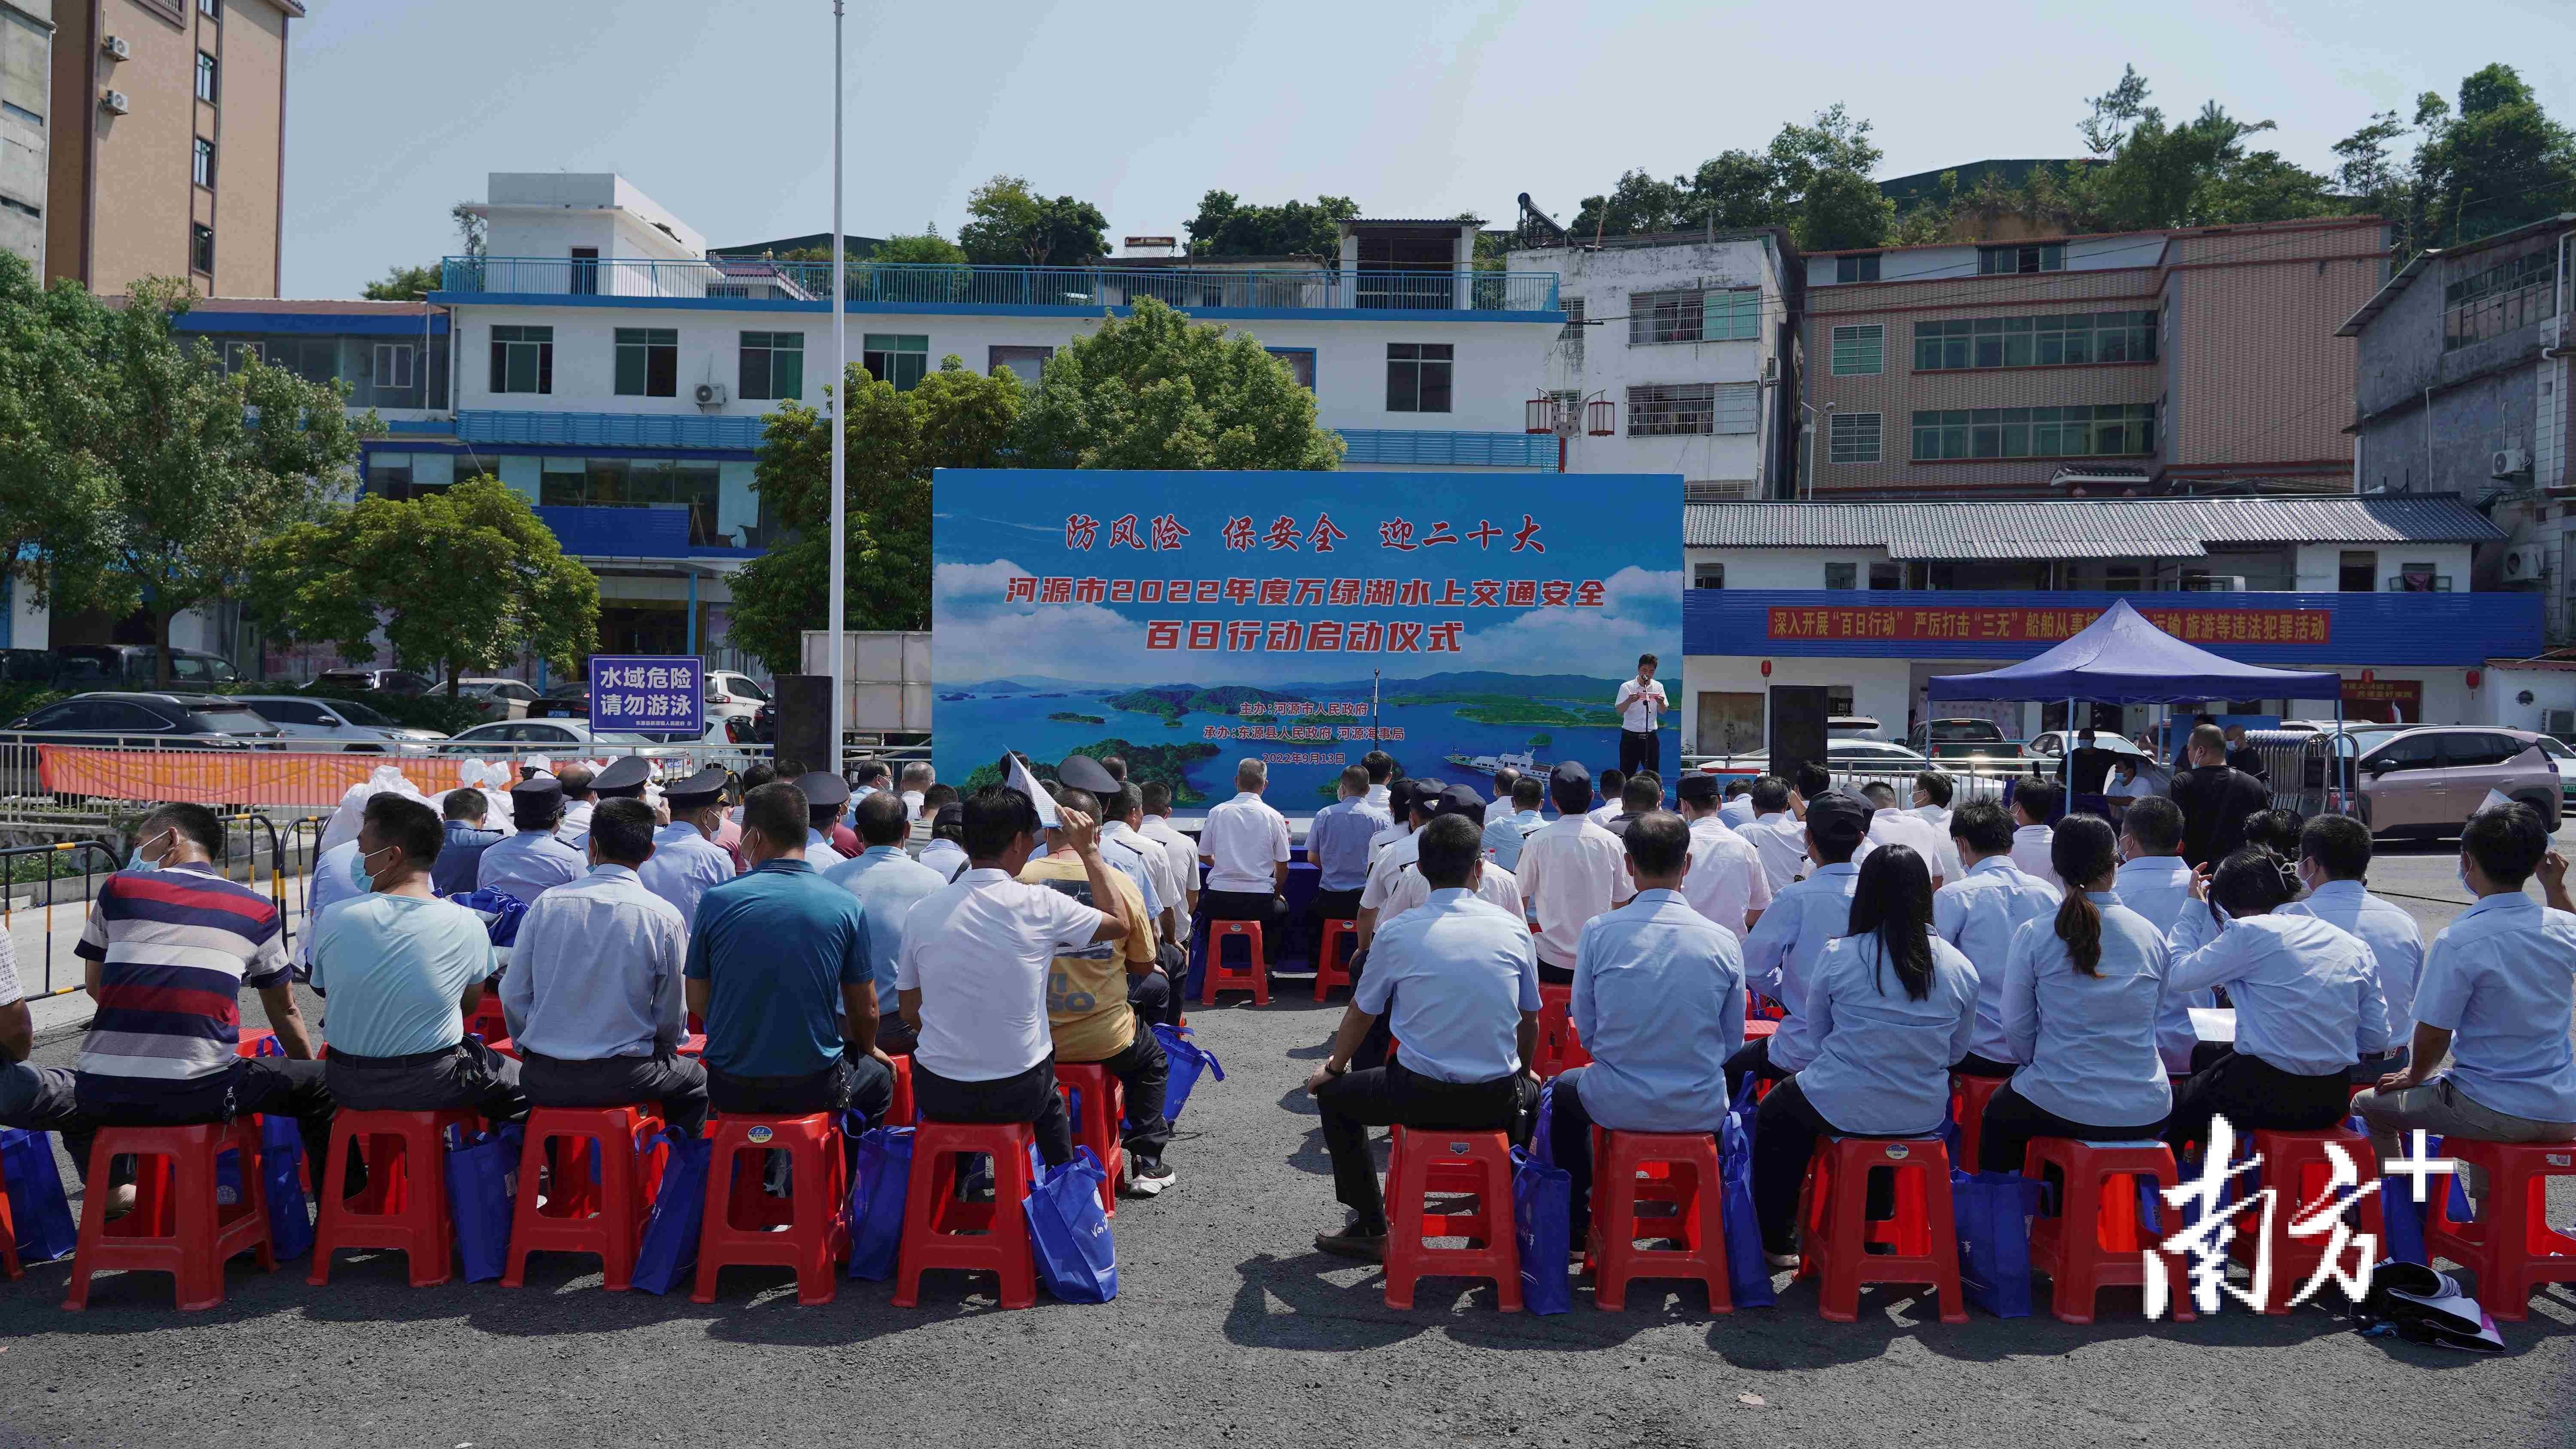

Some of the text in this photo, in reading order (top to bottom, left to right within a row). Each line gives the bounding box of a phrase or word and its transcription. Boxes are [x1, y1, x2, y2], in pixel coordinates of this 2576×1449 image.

[1066, 512, 1546, 554] 防风险 保安全 迎二十大
[1004, 577, 1606, 607] 河源市2022年度万绿湖水上交通安全
[1145, 620, 1464, 653] 百日行动启动仪式
[600, 667, 692, 689] 水域危险
[600, 694, 693, 716] 请勿游泳
[1337, 726, 1405, 741] 河源海事局
[1263, 752, 1346, 765] 2022年9月13日
